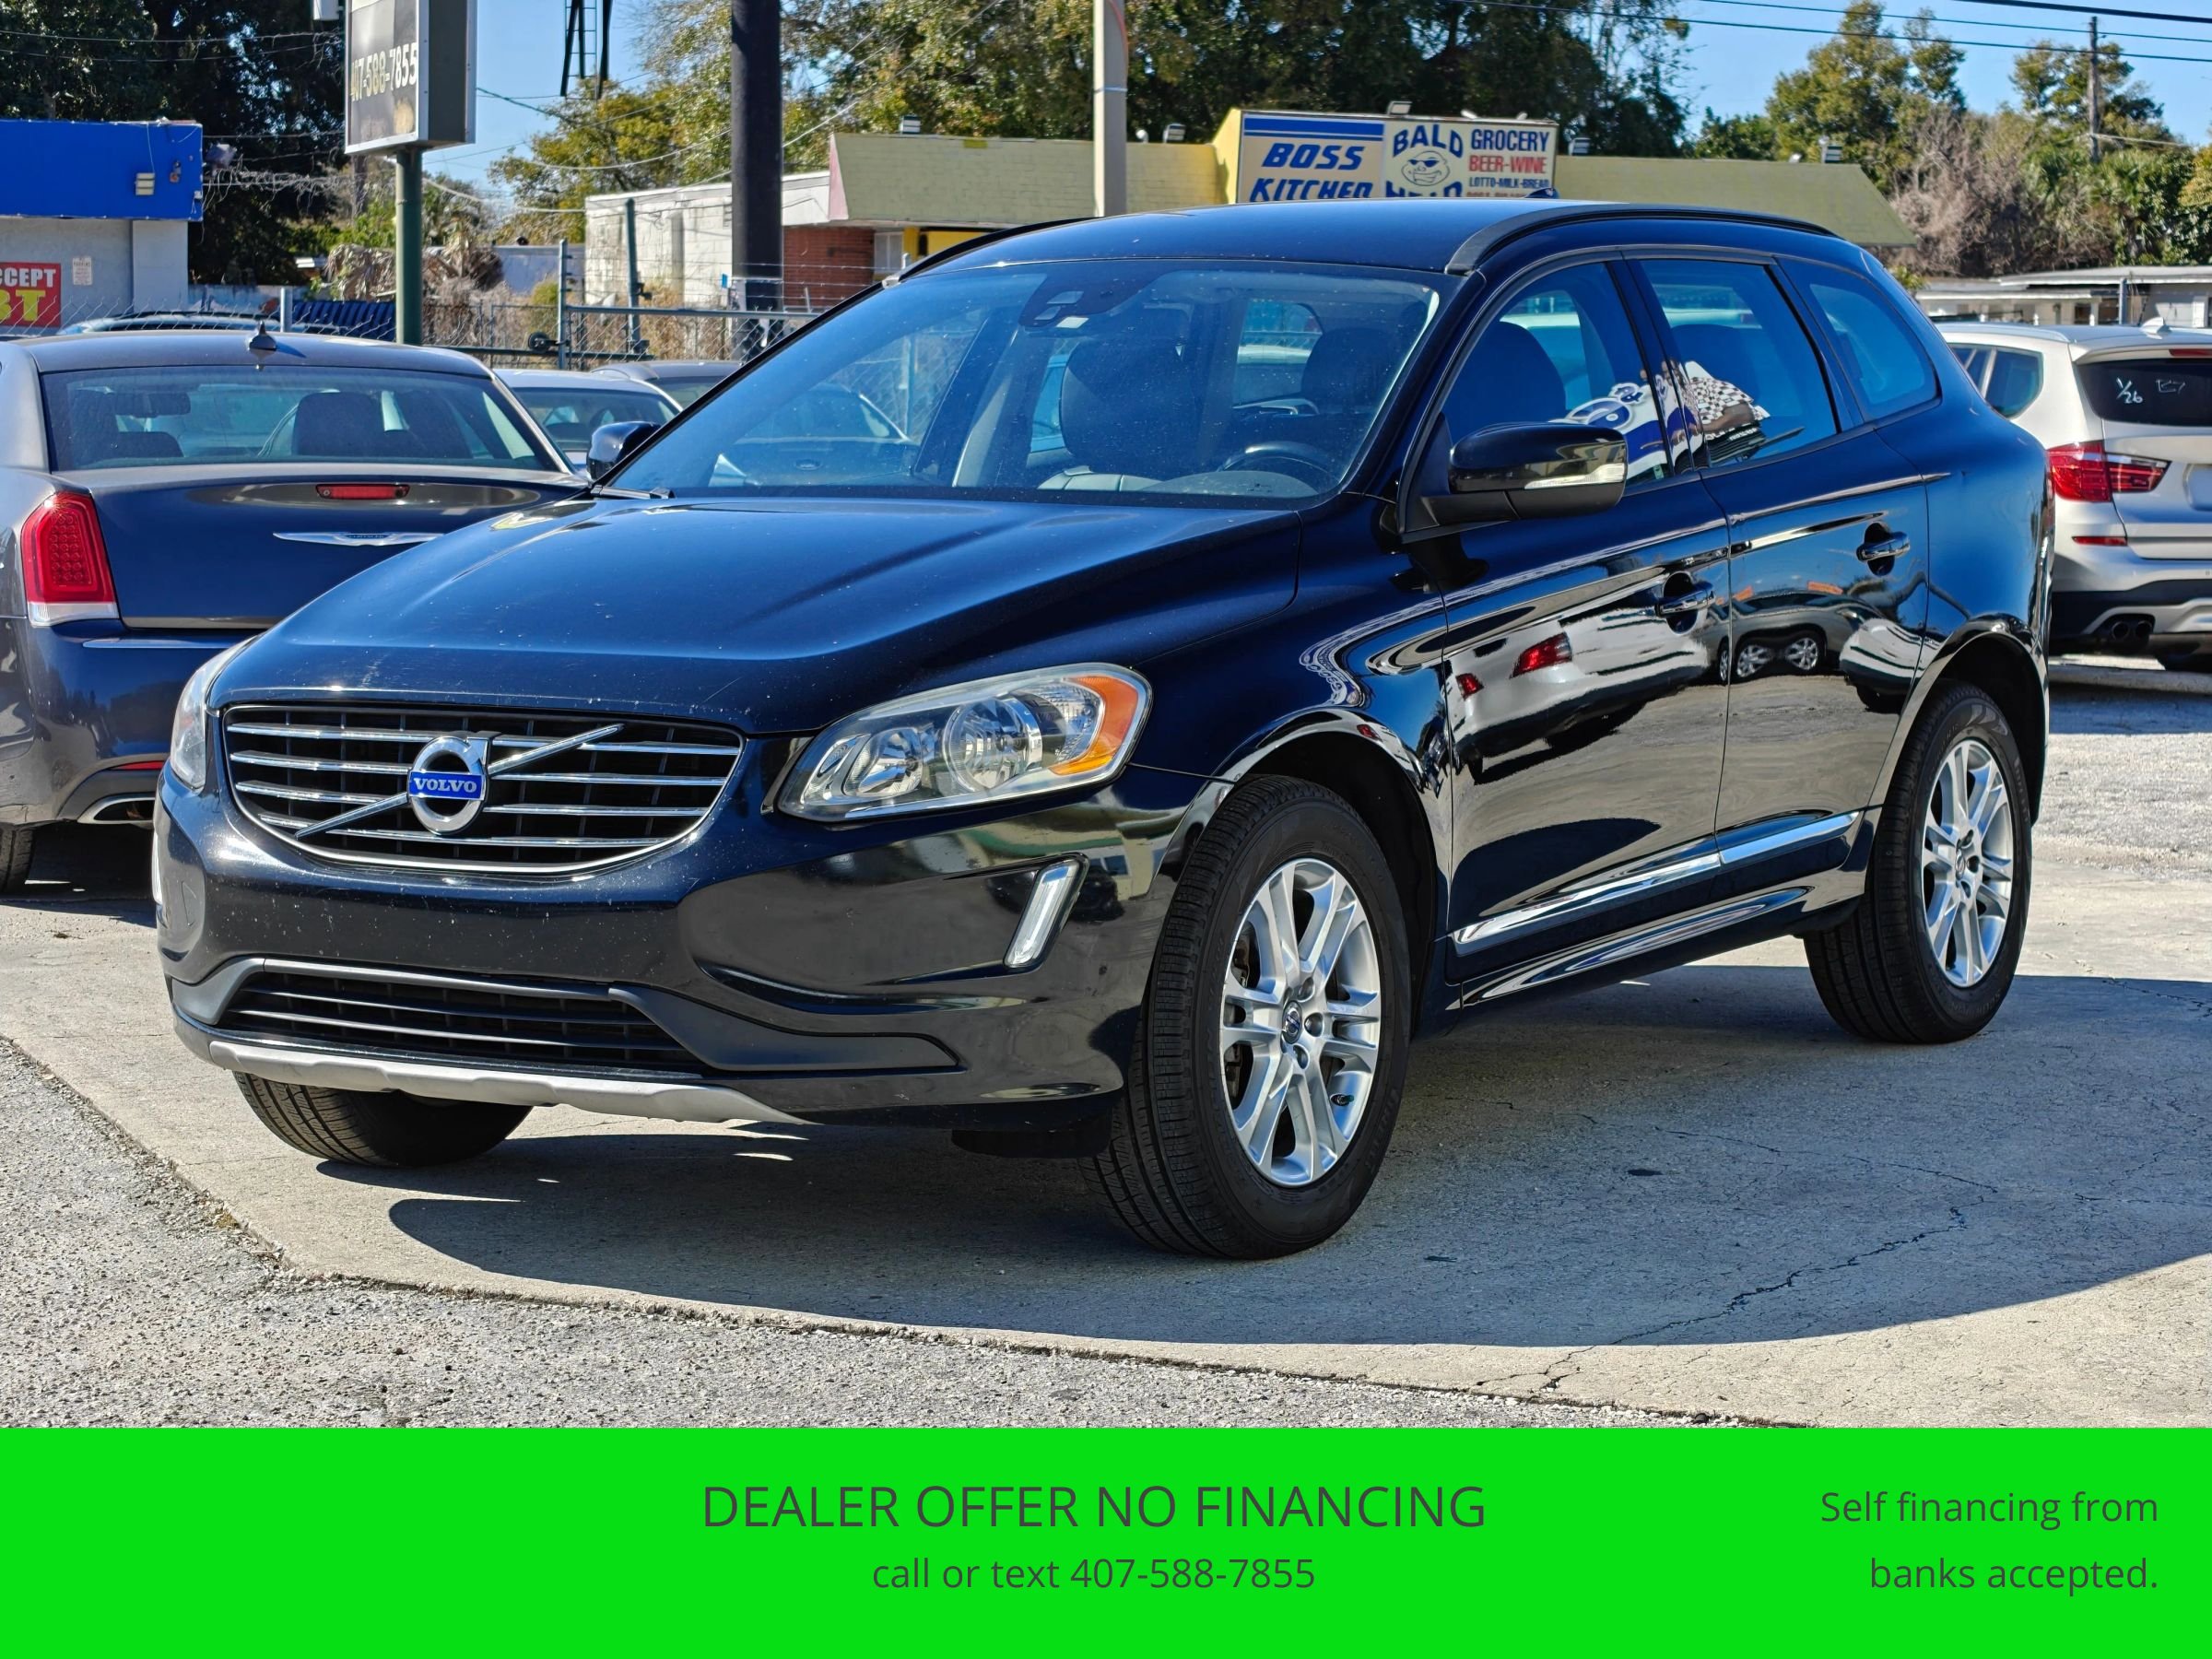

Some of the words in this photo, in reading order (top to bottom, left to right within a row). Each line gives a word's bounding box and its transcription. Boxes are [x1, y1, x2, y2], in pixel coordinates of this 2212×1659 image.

[350, 42, 418, 101] 407-588-7855
[1393, 124, 1464, 159] BALD
[1471, 129, 1550, 152] GROCERY
[1262, 143, 1365, 170] BOSS
[1469, 155, 1547, 173] BEER-WINE
[0, 267, 56, 288] CEPT
[414, 777, 477, 793] VOLVO
